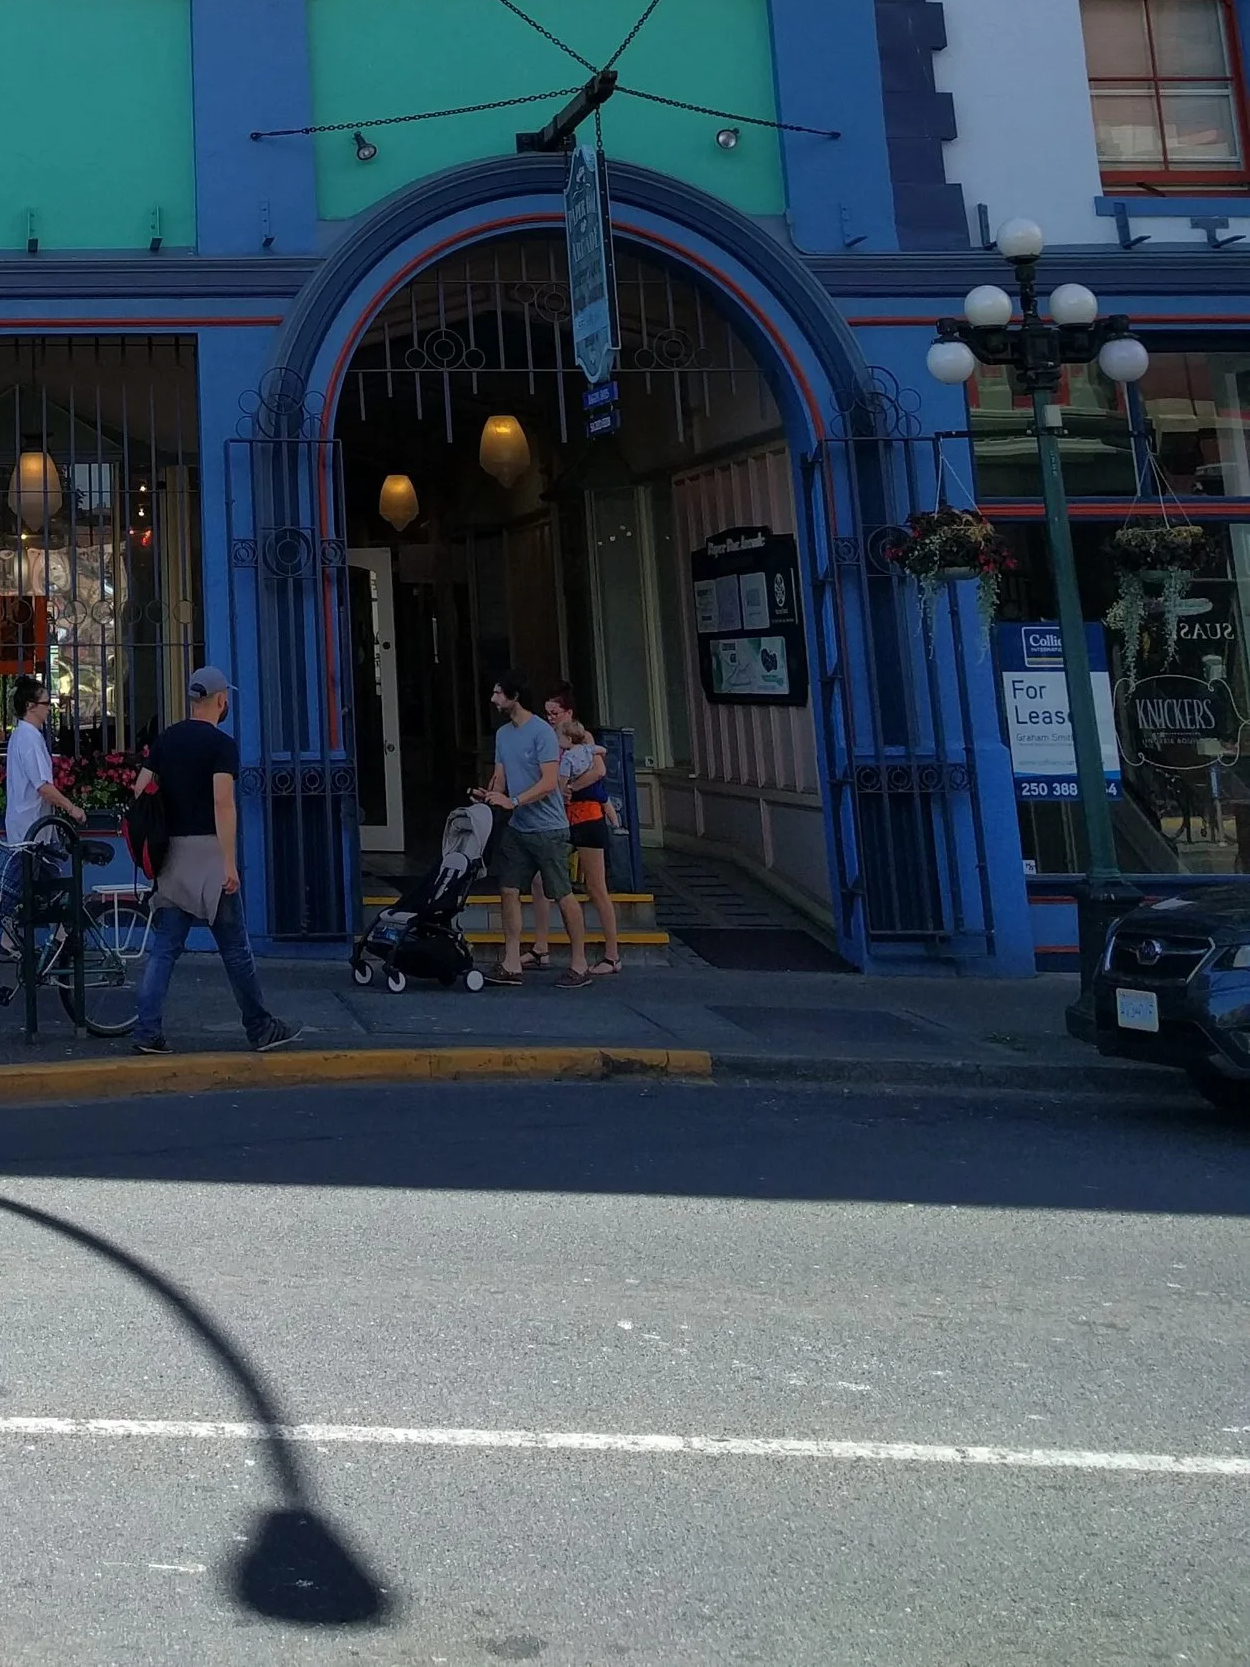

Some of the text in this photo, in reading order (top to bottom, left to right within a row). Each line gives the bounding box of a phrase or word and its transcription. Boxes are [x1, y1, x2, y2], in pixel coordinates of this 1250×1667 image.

[1011, 680, 1047, 700] For
[1135, 698, 1216, 730] KNICKERS
[1016, 733, 1049, 742] Graham
[1021, 783, 1048, 796] 250
[1052, 783, 1078, 796] 388
